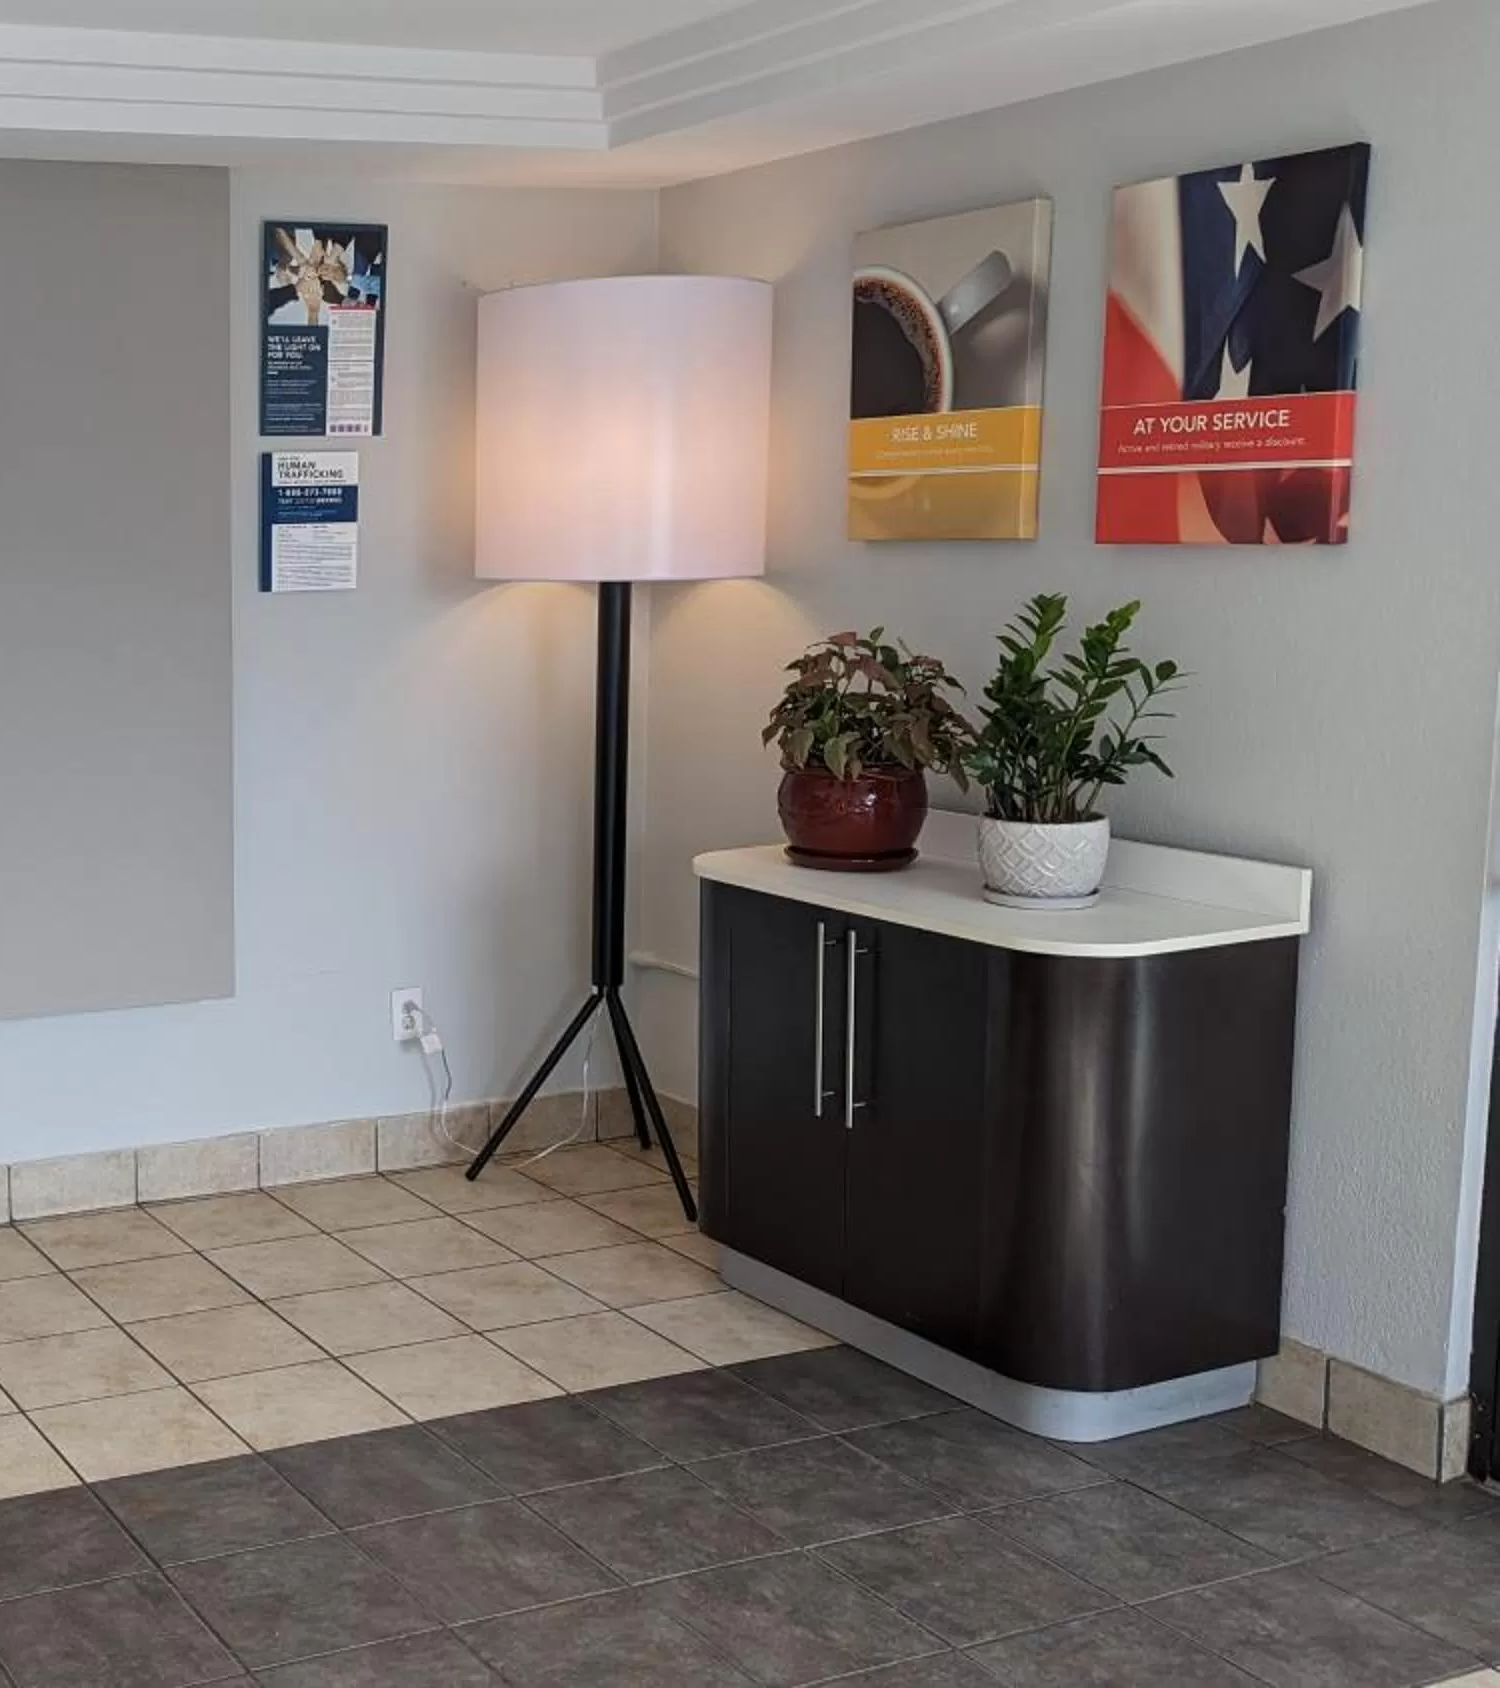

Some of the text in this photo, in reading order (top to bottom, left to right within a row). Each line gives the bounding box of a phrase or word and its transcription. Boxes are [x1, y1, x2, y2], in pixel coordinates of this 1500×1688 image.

[892, 422, 978, 442] RISE & SHINE
[1133, 408, 1291, 435] AT YOUR SERVICE
